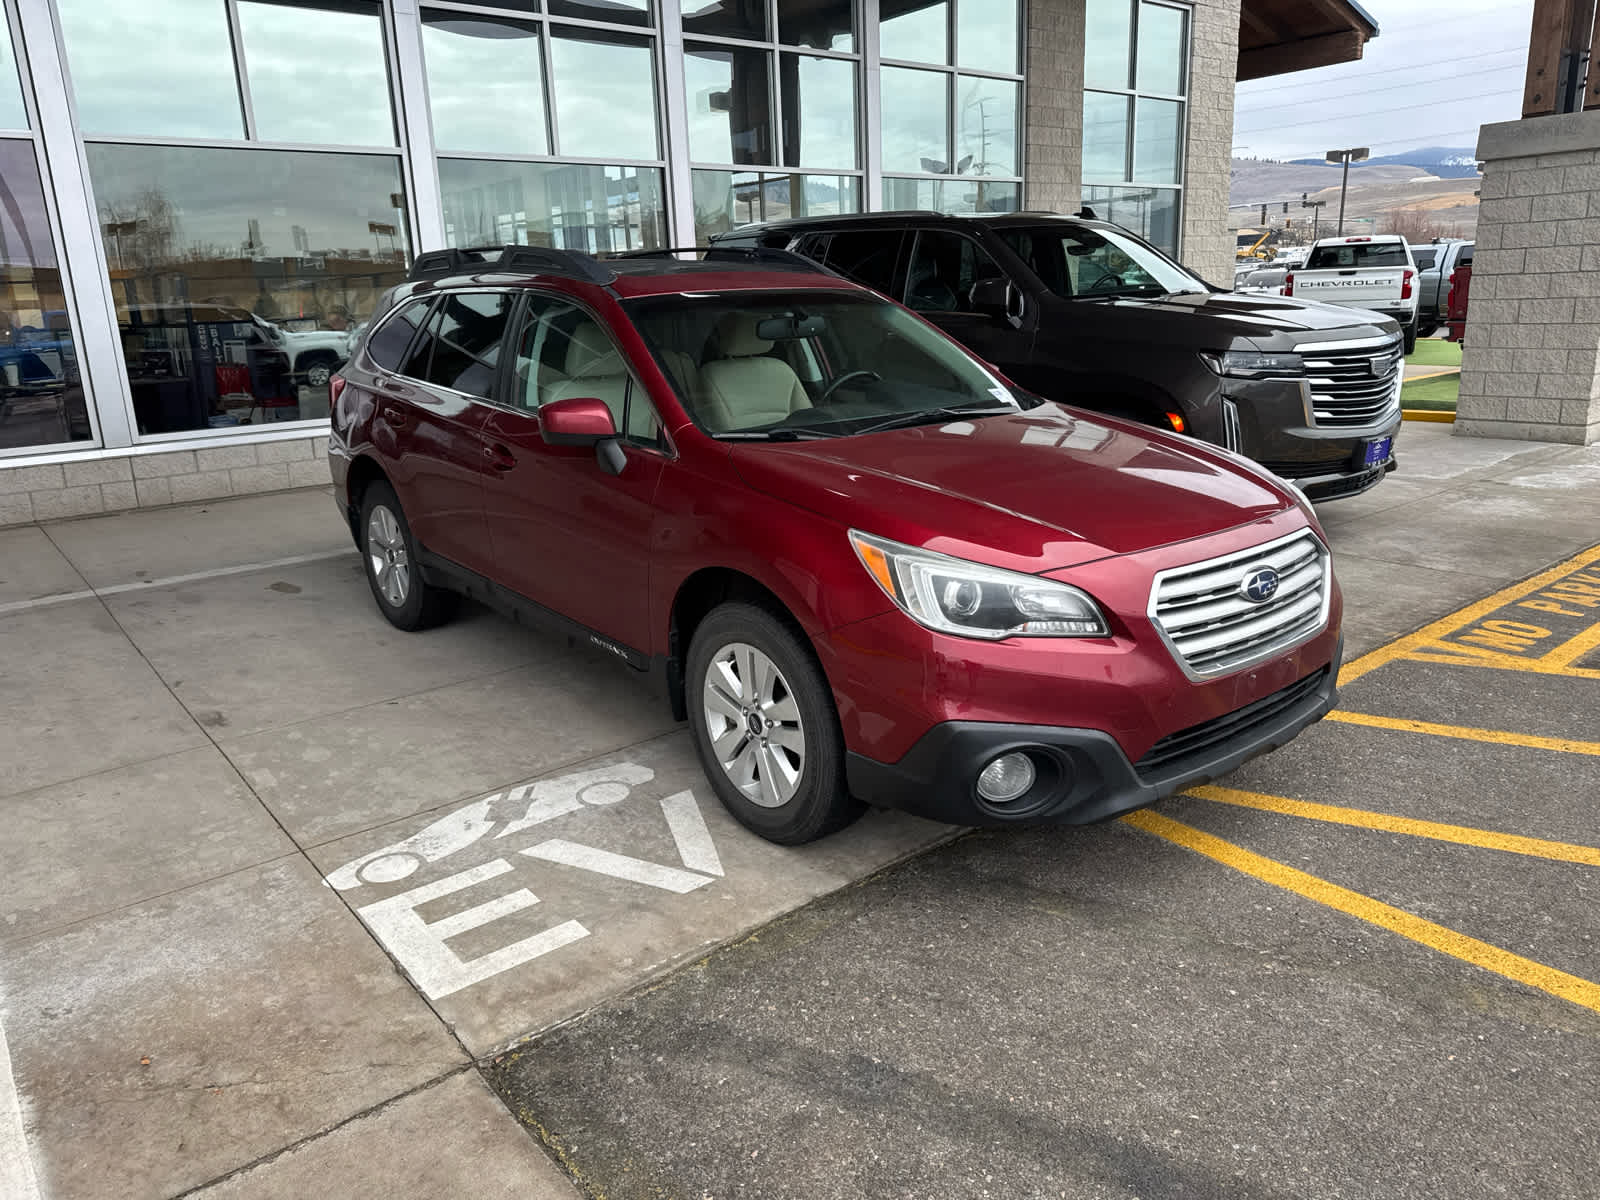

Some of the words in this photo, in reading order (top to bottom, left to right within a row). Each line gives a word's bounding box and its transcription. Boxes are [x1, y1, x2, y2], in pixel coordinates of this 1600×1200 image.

[1300, 279, 1393, 288] CHEVROLET
[1457, 620, 1552, 652] NO
[357, 789, 725, 1000] EV
